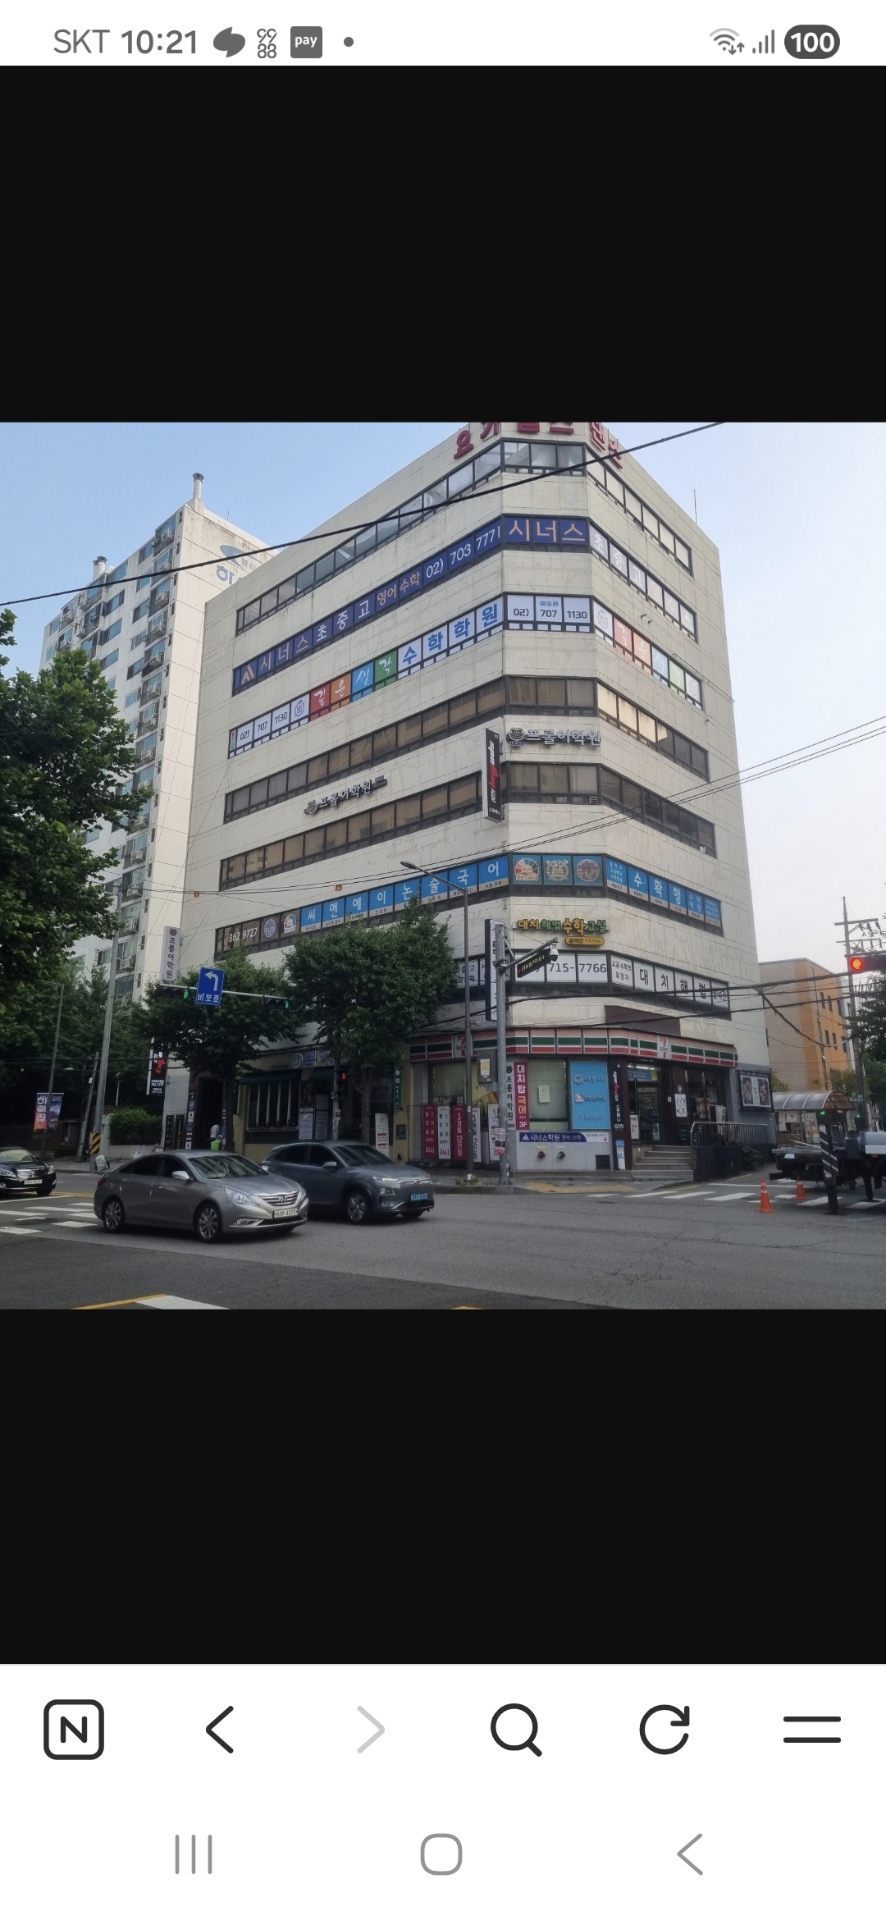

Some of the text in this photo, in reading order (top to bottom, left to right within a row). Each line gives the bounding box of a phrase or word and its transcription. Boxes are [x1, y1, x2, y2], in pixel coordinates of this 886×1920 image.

[508, 519, 586, 543] 시너스
[593, 532, 642, 587] 초중고
[260, 526, 500, 672] 시너스 초중고 영어 수학 02) 703 7771
[513, 608, 588, 619] 02) 707 1130
[402, 602, 498, 666] 수학학원
[257, 721, 269, 733] 707
[274, 711, 288, 724] 1130
[527, 729, 601, 747] 프롤어학원
[633, 872, 681, 906] 수확행
[229, 932, 241, 943] 362
[243, 927, 258, 940] 9727
[517, 918, 607, 937] 대치 해법 수학 교실
[166, 938, 177, 979] 프롤어학원
[197, 993, 220, 1004] 비보호
[530, 1133, 560, 1141] 시너스학원
